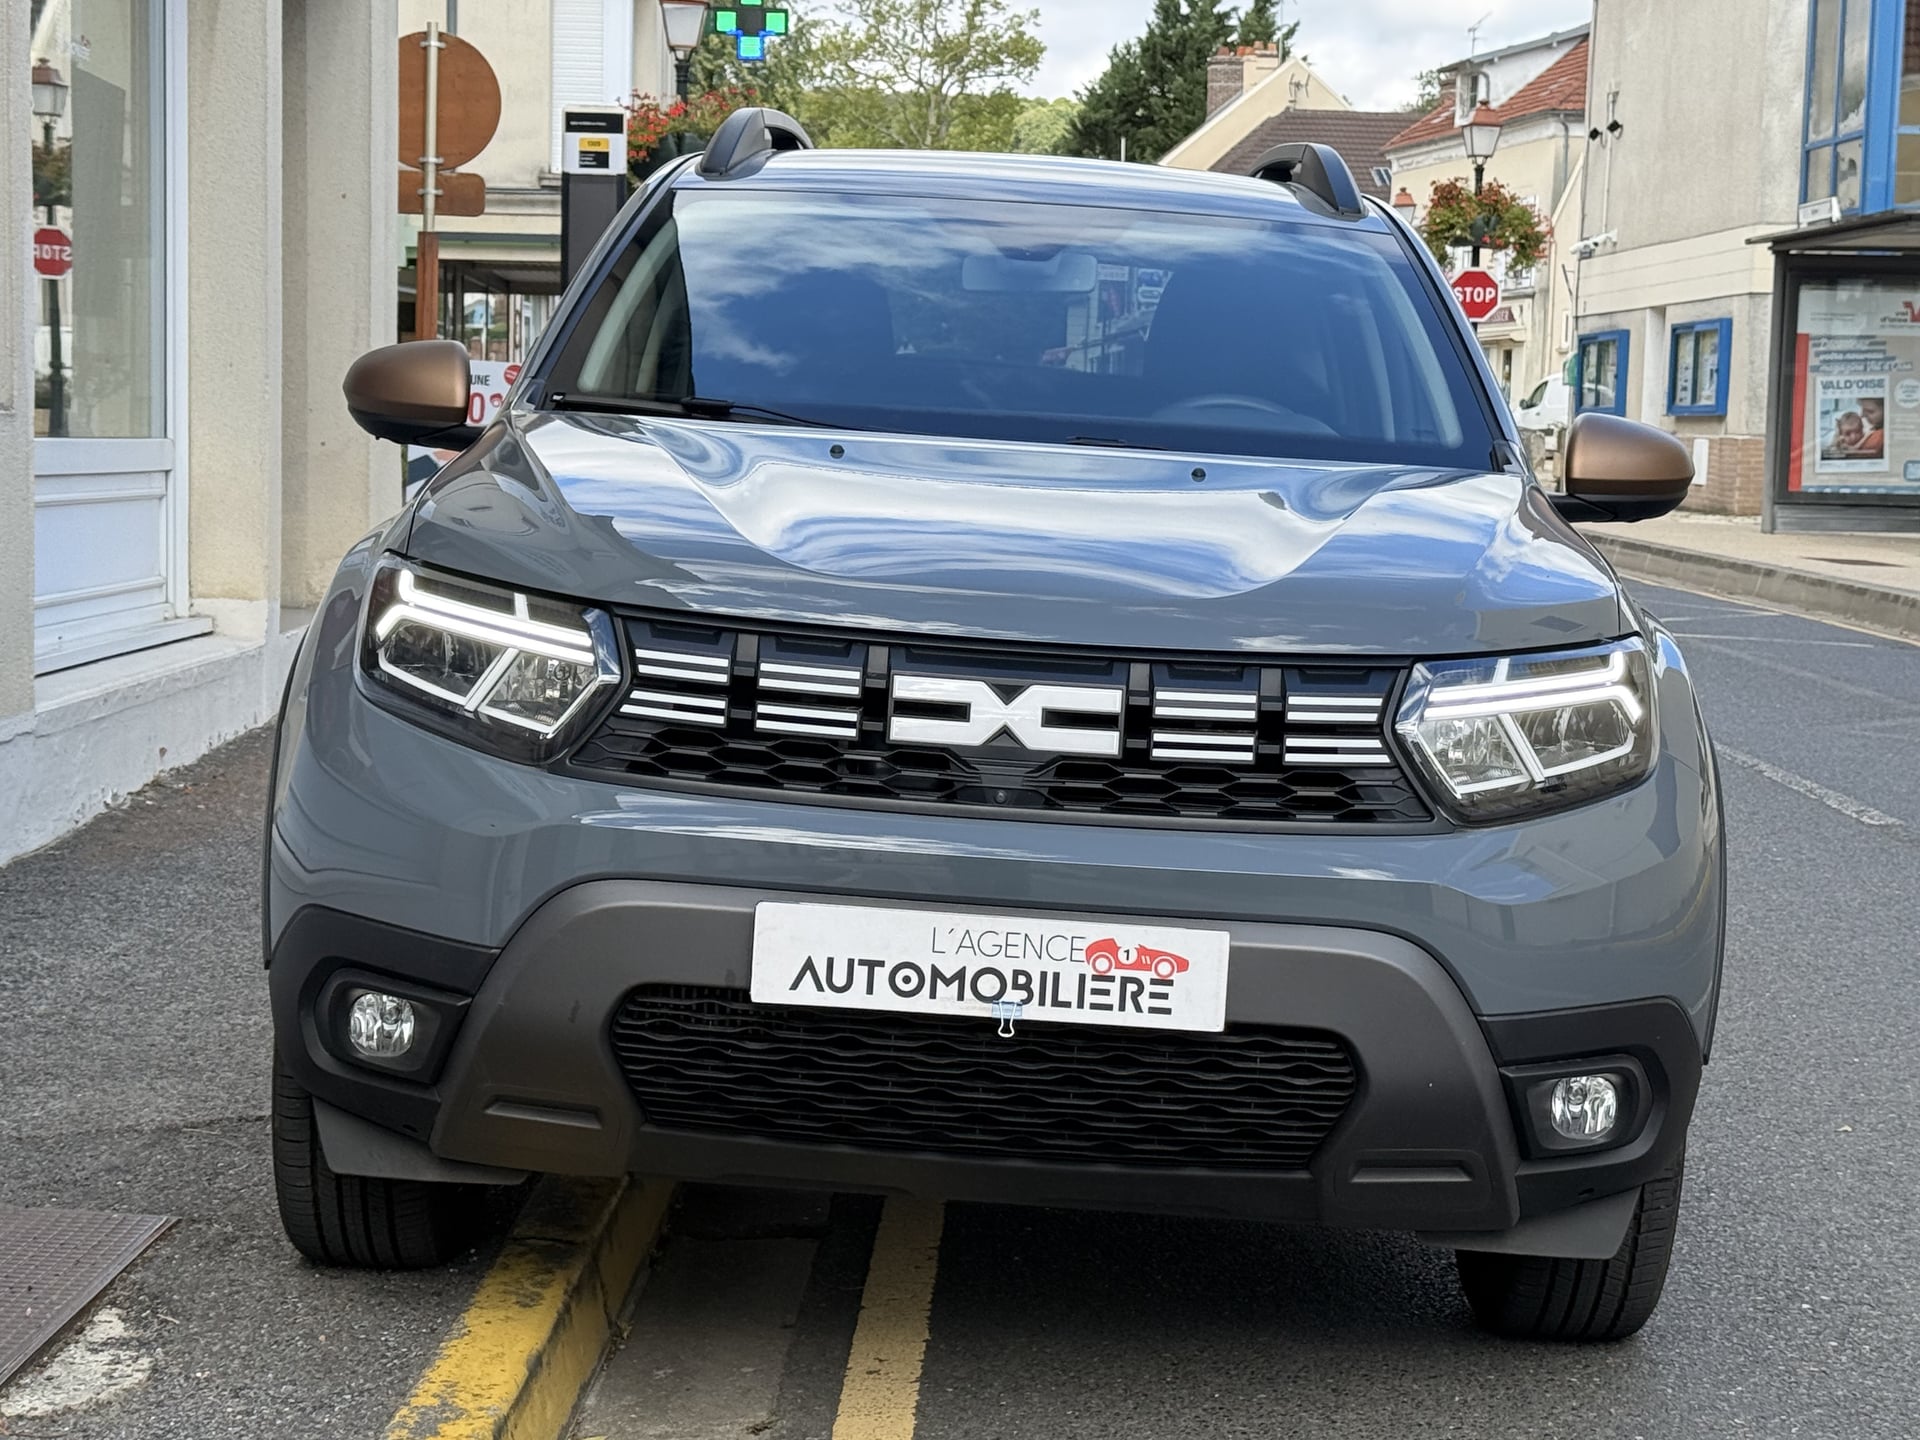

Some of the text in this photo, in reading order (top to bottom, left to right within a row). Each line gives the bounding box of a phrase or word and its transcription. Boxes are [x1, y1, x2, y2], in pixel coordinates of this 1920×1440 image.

[1453, 286, 1496, 303] STOP
[932, 927, 1087, 963] L'AGENCE
[1121, 948, 1132, 962] 1
